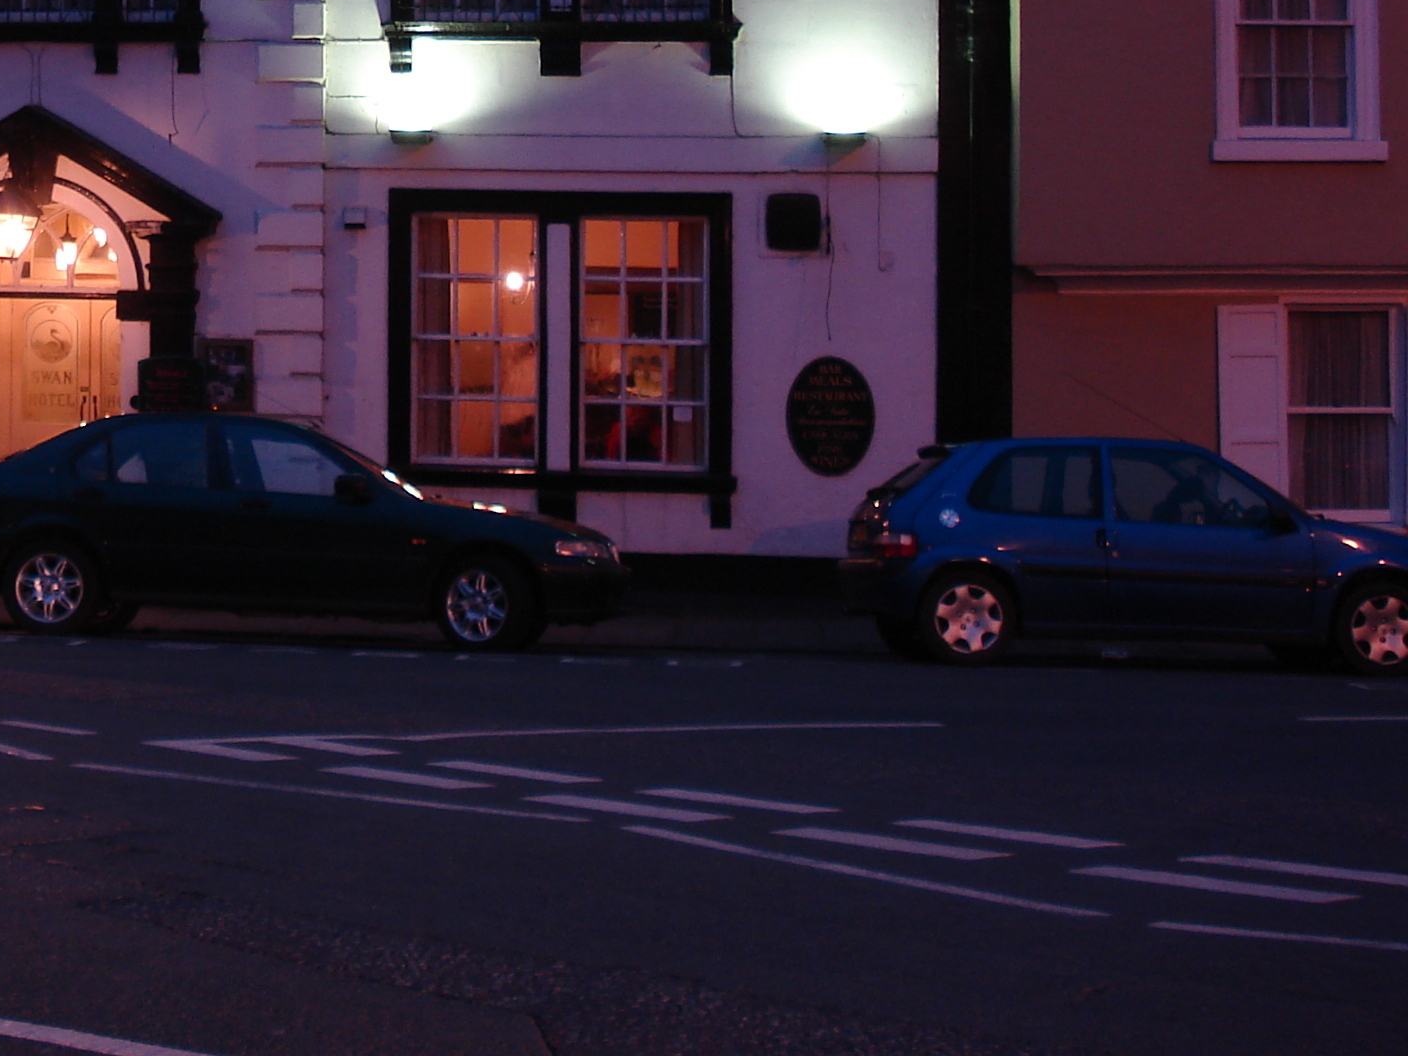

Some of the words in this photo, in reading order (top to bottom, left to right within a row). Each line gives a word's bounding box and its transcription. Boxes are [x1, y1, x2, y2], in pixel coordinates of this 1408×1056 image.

[819, 365, 842, 375] BAR
[32, 371, 73, 385] SWAN
[808, 376, 853, 386] MEALS
[28, 393, 74, 407] HOTEL
[793, 390, 869, 401] RESTAURANT
